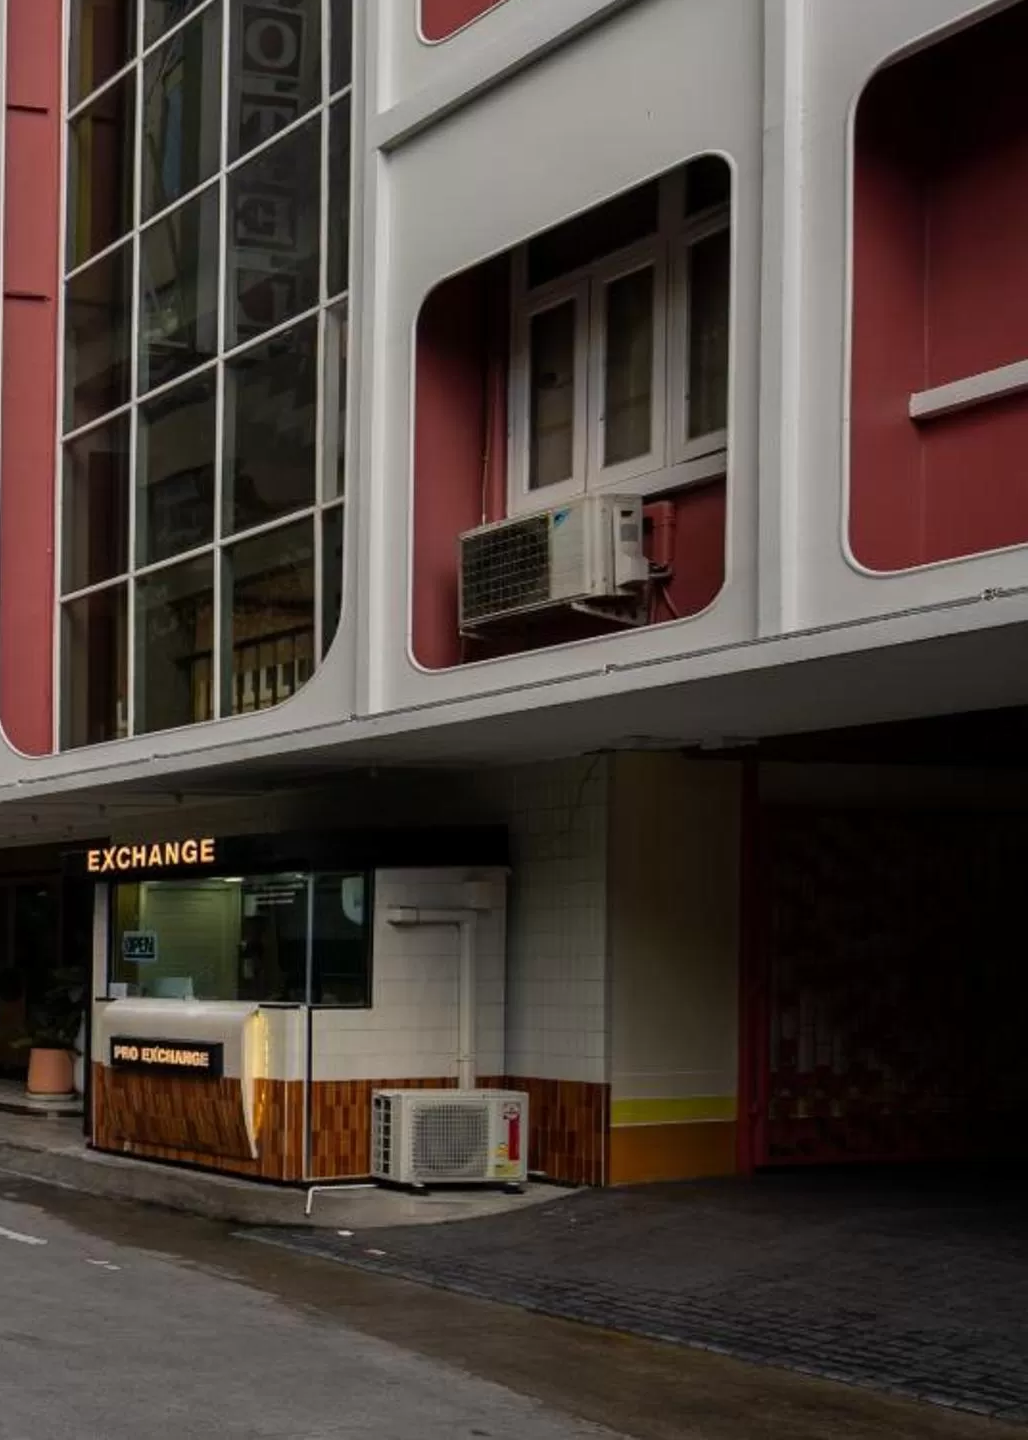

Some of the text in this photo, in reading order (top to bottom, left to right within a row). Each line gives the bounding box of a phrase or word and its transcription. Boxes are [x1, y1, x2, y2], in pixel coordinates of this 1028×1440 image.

[87, 838, 215, 872] EXCHANGE
[124, 936, 154, 953] OPEN
[113, 1045, 209, 1066] PRO EXCHANGE
